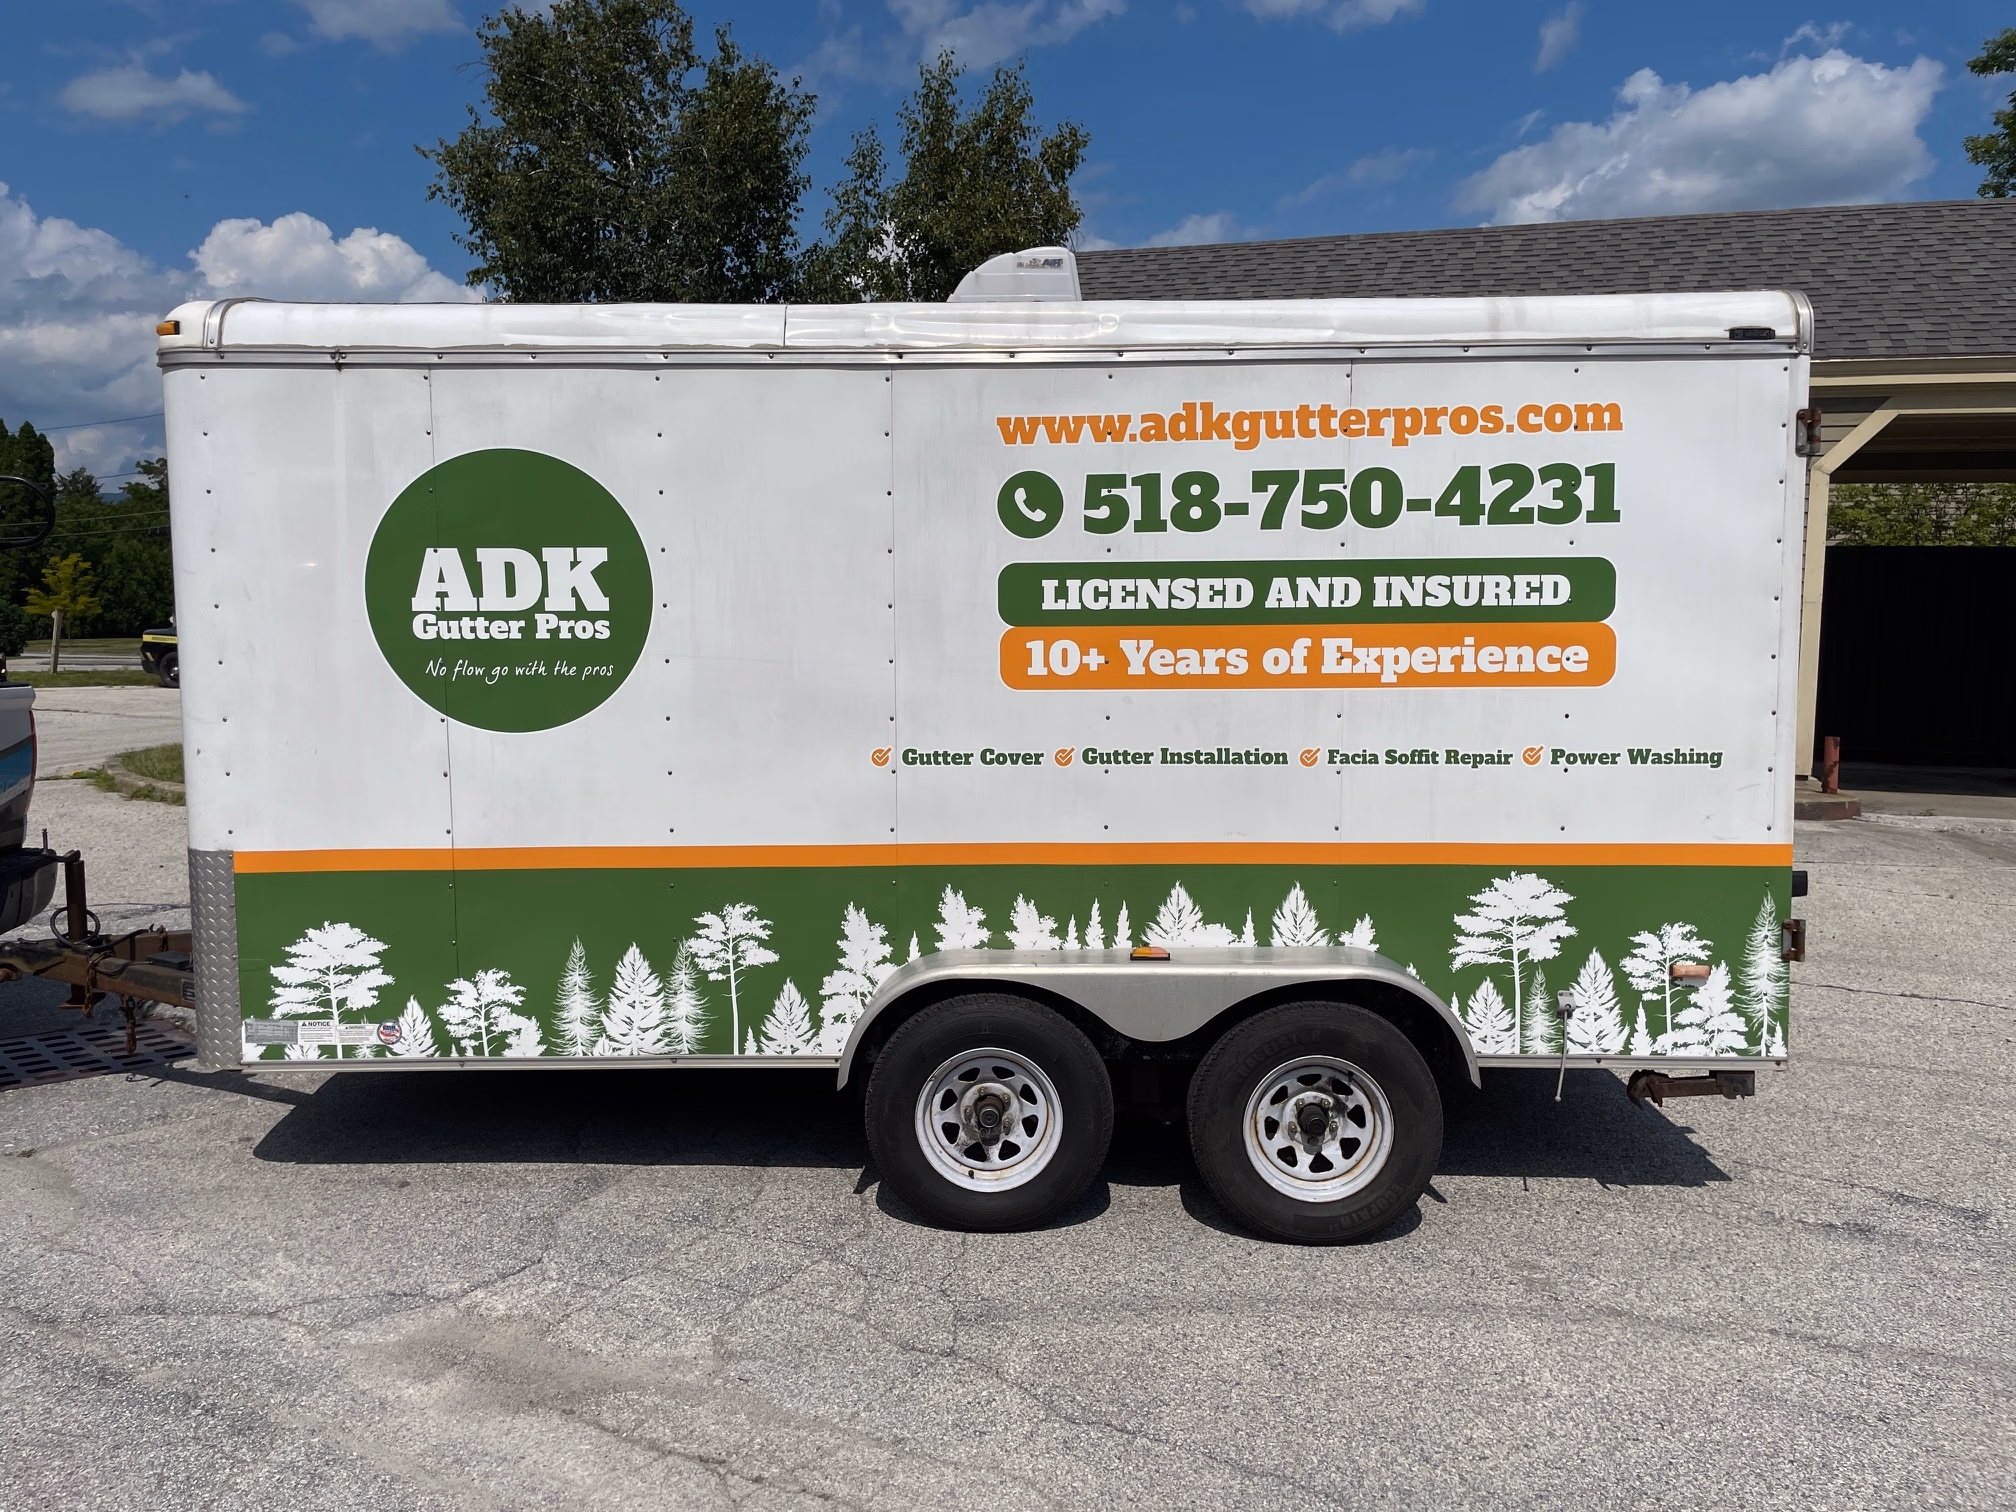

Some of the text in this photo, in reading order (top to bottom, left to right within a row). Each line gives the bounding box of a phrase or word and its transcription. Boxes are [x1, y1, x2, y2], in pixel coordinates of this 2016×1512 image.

[997, 402, 1623, 450] www.adkgutterpros.com
[1083, 463, 1621, 535] 518-750-4231
[411, 547, 610, 612] ADK
[1042, 574, 1572, 611] LICENSED AND INSURED
[412, 613, 611, 640] Gutter Pros
[425, 658, 614, 684] No flow go with the pros
[1026, 637, 1589, 682] 10+ Years of Experience
[902, 748, 1045, 766] Gutter Cover
[1082, 747, 1289, 765] Gutter Installation
[1327, 748, 1514, 769] Facia Soffit Repair
[1550, 748, 1723, 769] Power Washing
